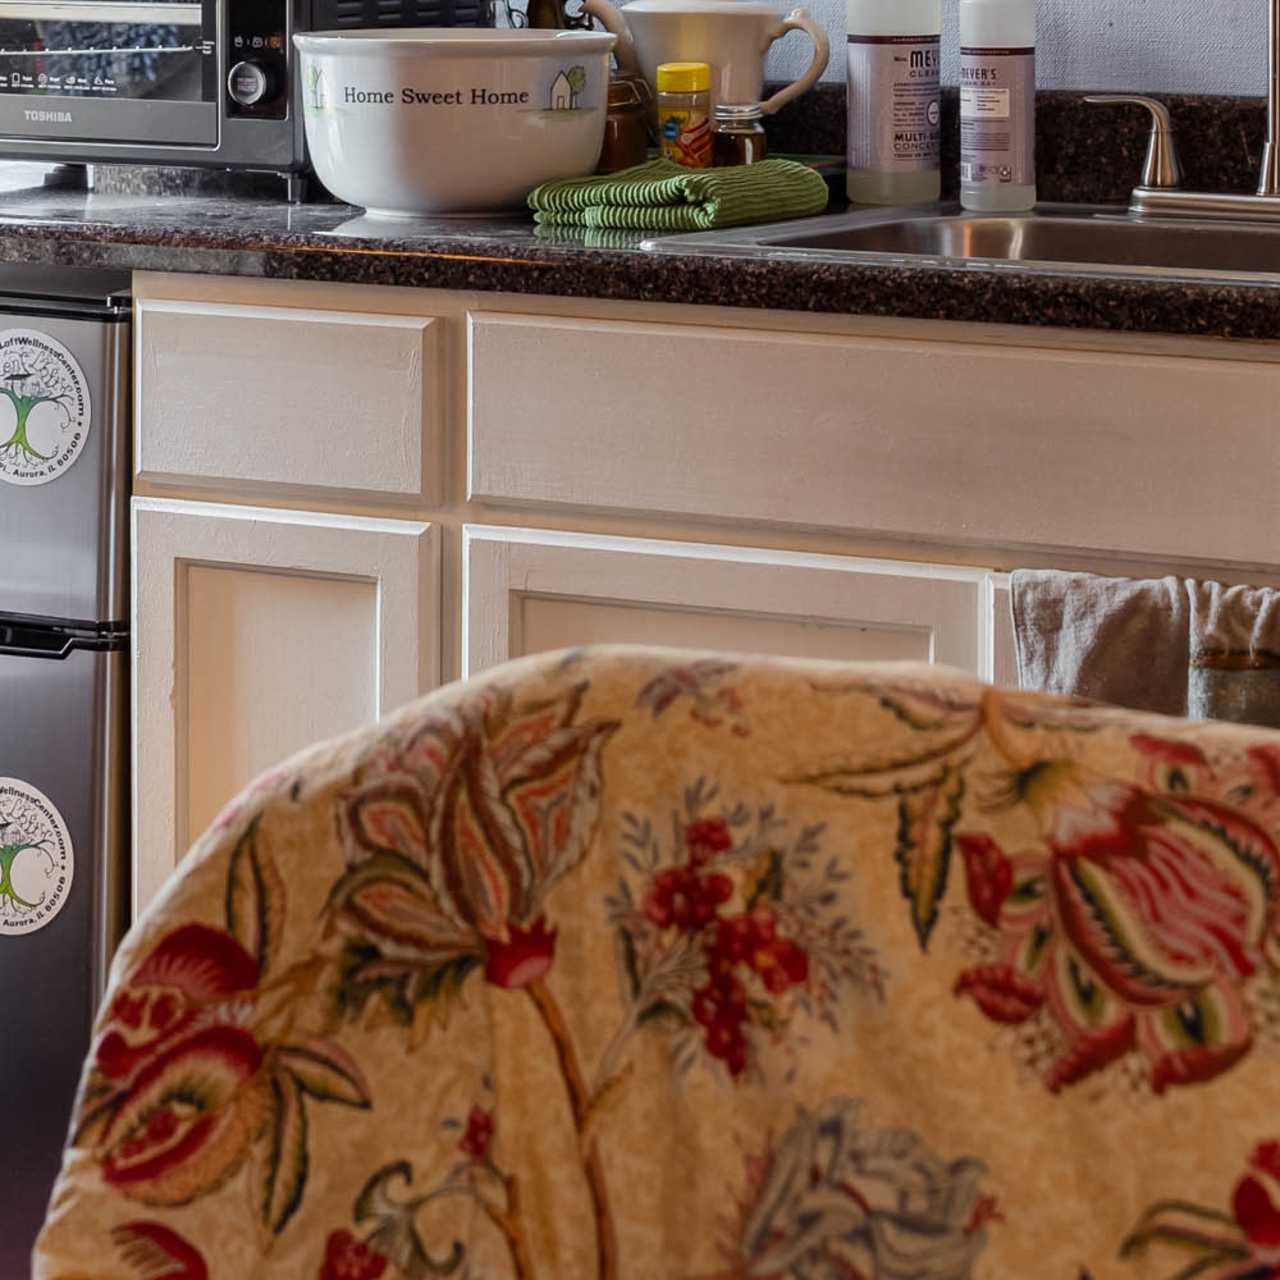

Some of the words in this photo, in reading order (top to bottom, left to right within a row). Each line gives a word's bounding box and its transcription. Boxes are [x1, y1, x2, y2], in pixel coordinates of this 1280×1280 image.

[344, 86, 394, 104] Home
[402, 87, 463, 105] Sweet
[471, 88, 530, 105] Home
[24, 110, 73, 122] TOSHIBA
